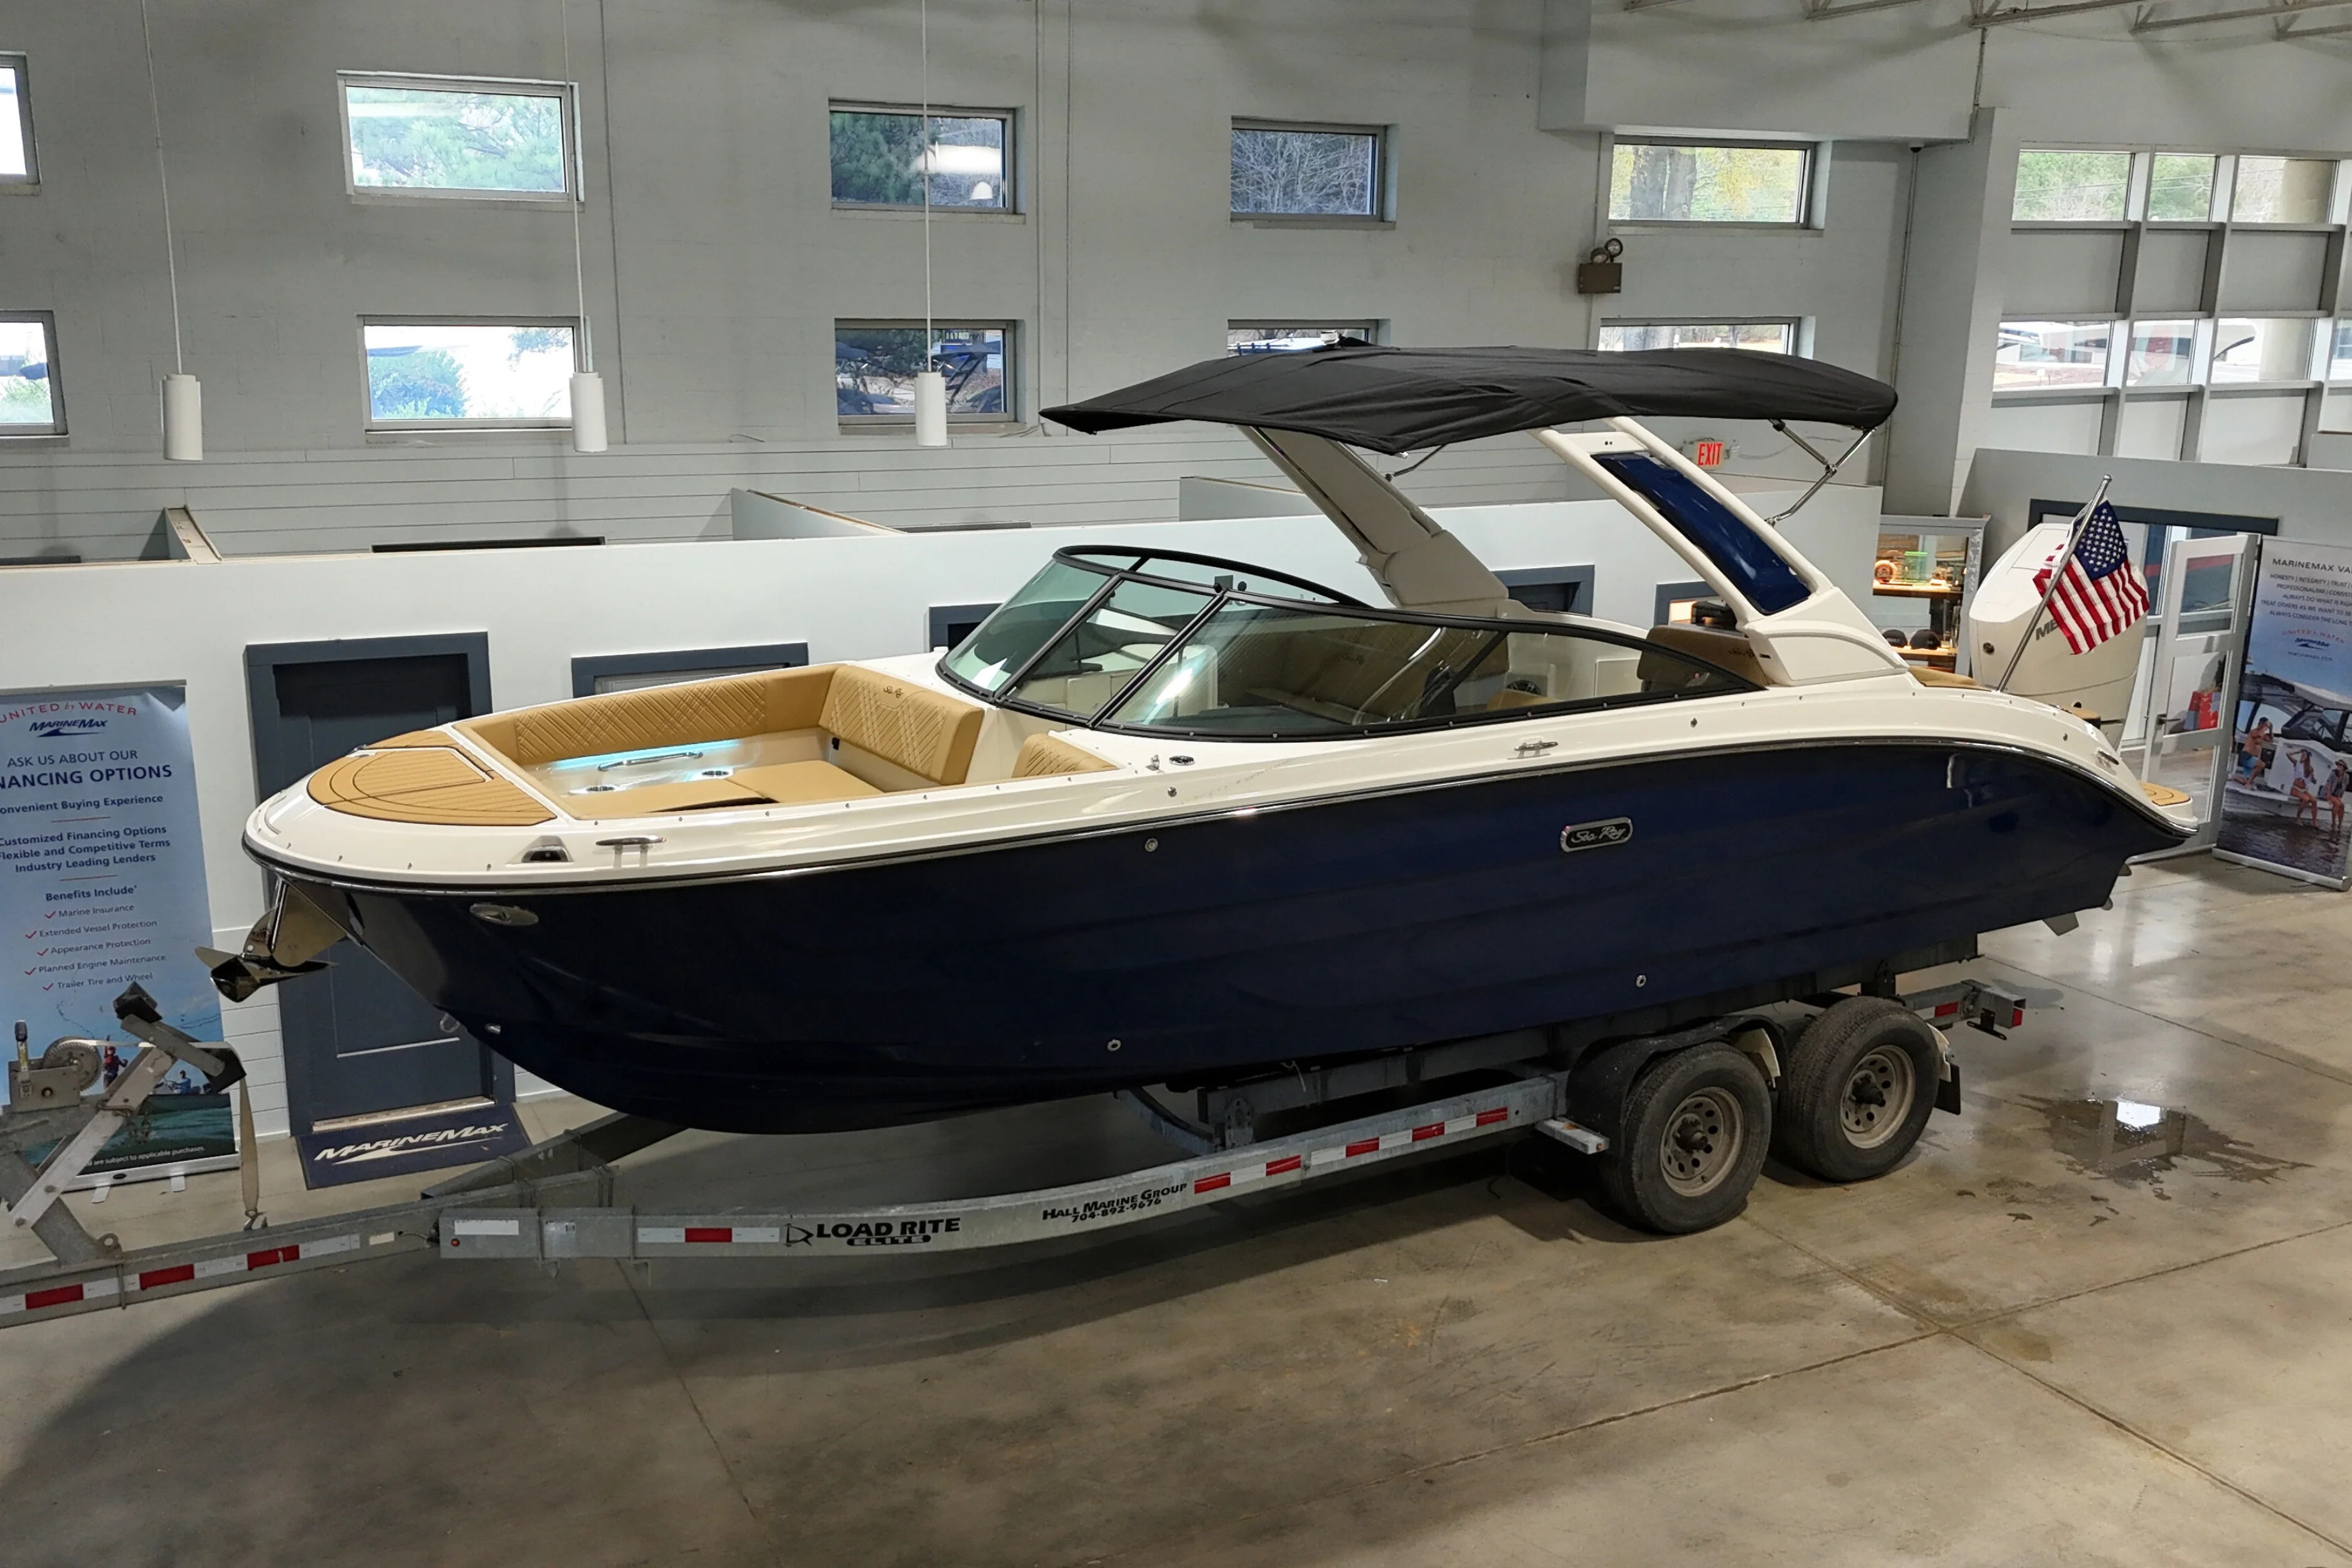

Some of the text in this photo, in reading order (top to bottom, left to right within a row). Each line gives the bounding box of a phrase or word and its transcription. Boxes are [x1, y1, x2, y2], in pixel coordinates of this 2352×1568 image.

[1698, 443, 1723, 466] EXIT
[2272, 558, 2352, 574] MARINEMAX VA
[65, 702, 75, 712] by
[80, 702, 137, 716] WATER
[7, 750, 138, 768] ASK US ABOUT OUR
[90, 765, 172, 783] OPTIONS
[0, 795, 163, 814] onvenient Buying Experience
[67, 829, 120, 840] Financing
[124, 825, 167, 838] Options
[1571, 825, 1626, 843] Sea Ray
[0, 839, 171, 860] lexible and Competitive Terms
[15, 854, 156, 873] Industry Leading Lenders
[46, 891, 91, 901] Benefits
[59, 904, 134, 918] Marine Insurance
[40, 920, 157, 937] Extended Vessel Protection
[51, 938, 151, 955] Appearance Protection
[39, 955, 166, 973] Planned Engine Maintenance
[58, 972, 153, 989] Trailer Tire and Wheel
[314, 1123, 508, 1161] MARINEMAX
[105, 1155, 129, 1165] subject
[138, 1150, 171, 1160] applicable
[1042, 1184, 1187, 1220] HALL MARINE GROUP
[1071, 1198, 1162, 1222] 704-892-9676
[817, 1217, 960, 1238] LOAD RITE
[854, 1234, 929, 1246] ELITE
